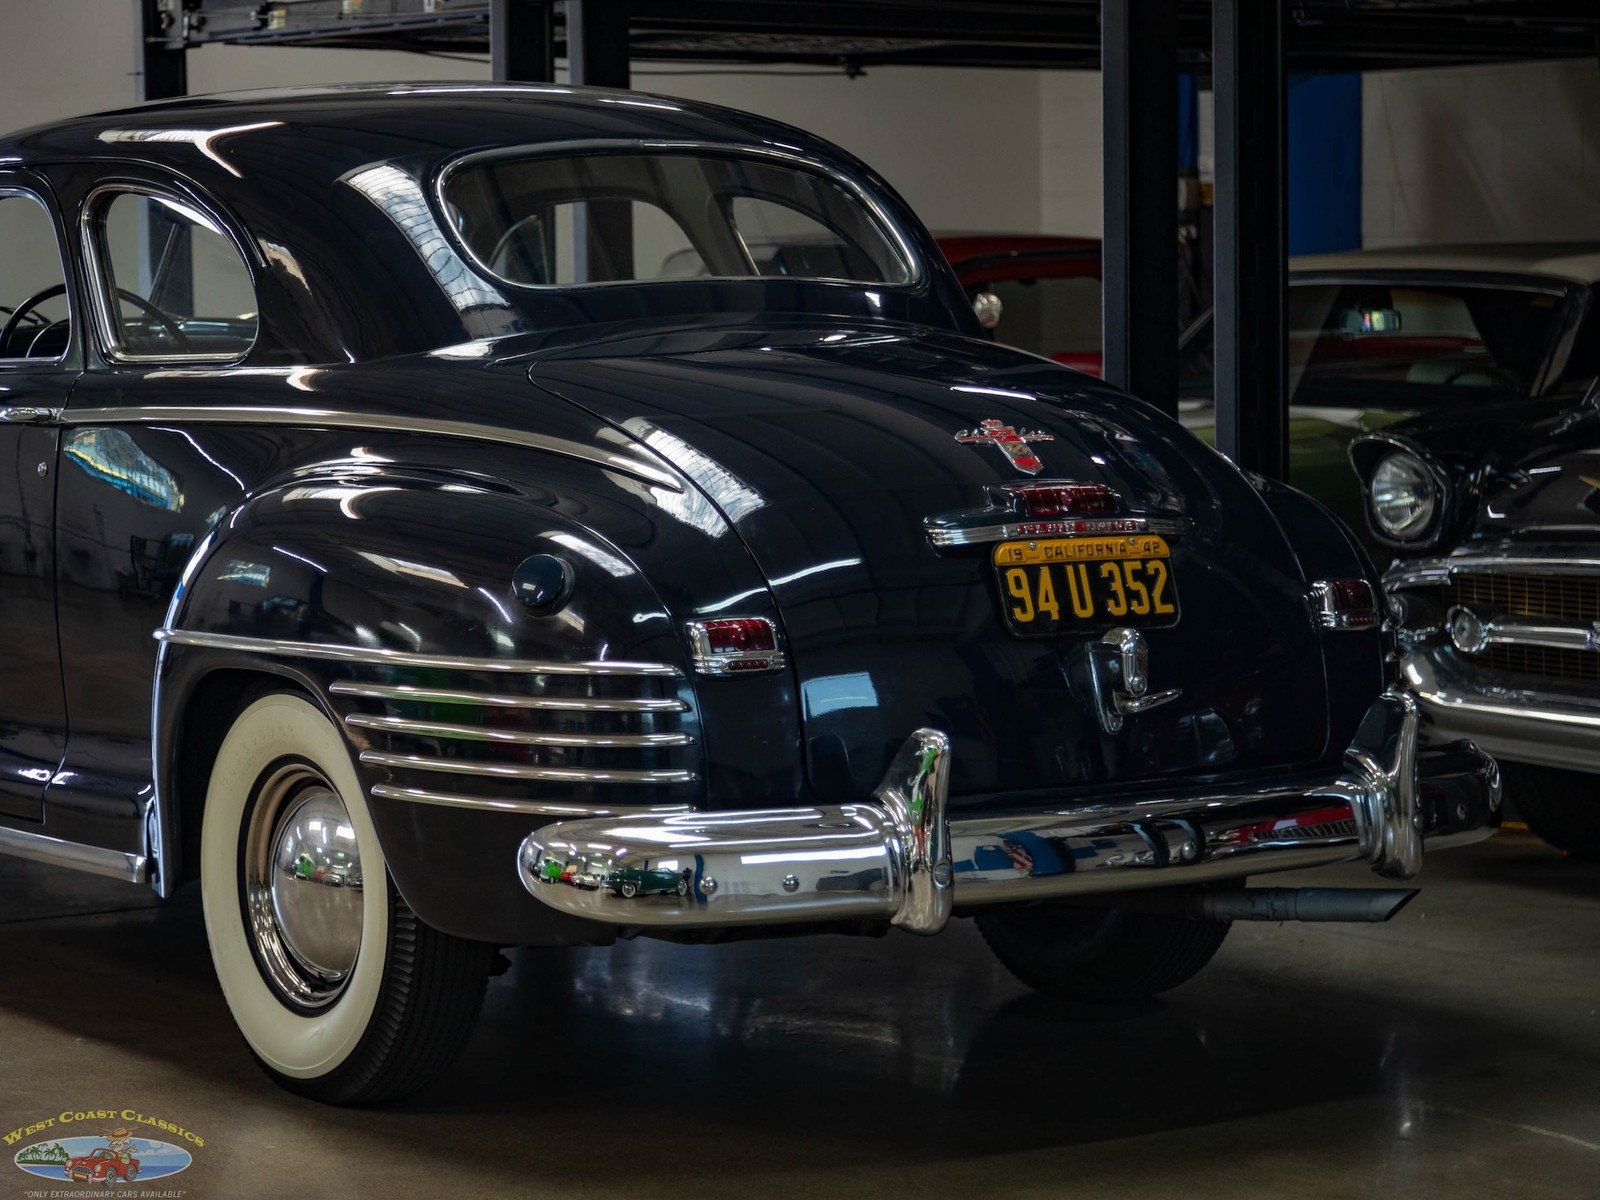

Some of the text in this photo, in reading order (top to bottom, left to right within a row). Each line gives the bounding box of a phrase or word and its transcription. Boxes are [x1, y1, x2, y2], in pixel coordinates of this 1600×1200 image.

[1007, 541, 1161, 561] 19 CALIFORNIA 42
[1005, 559, 1175, 623] 94 U 352
